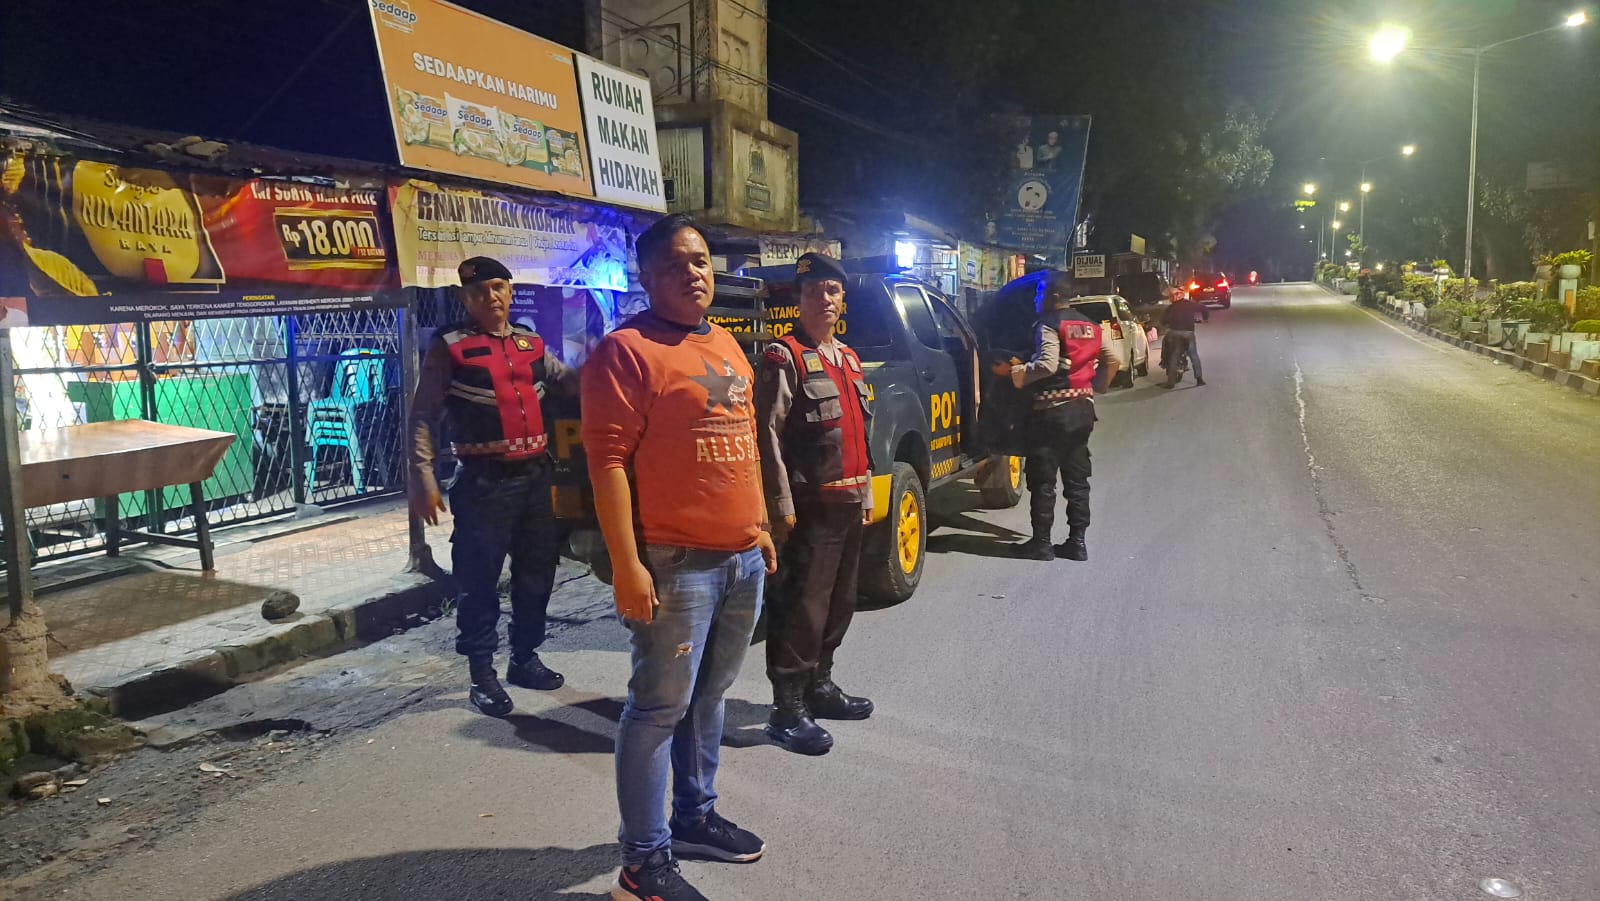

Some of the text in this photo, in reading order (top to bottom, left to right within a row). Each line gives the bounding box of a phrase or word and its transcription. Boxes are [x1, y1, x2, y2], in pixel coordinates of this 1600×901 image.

[371, 0, 417, 23] Sedaap
[413, 52, 558, 110] SEDAAPKAN HARIMU
[591, 71, 645, 115] RUMAH
[414, 101, 448, 117] Sedaap
[457, 110, 492, 128] Sedaap
[513, 123, 542, 139] Sedaap
[597, 115, 650, 155] MAKAN
[599, 157, 660, 196] HIDAYAH
[469, 197, 519, 228] MAKAN
[1076, 256, 1103, 265] DIJUAL
